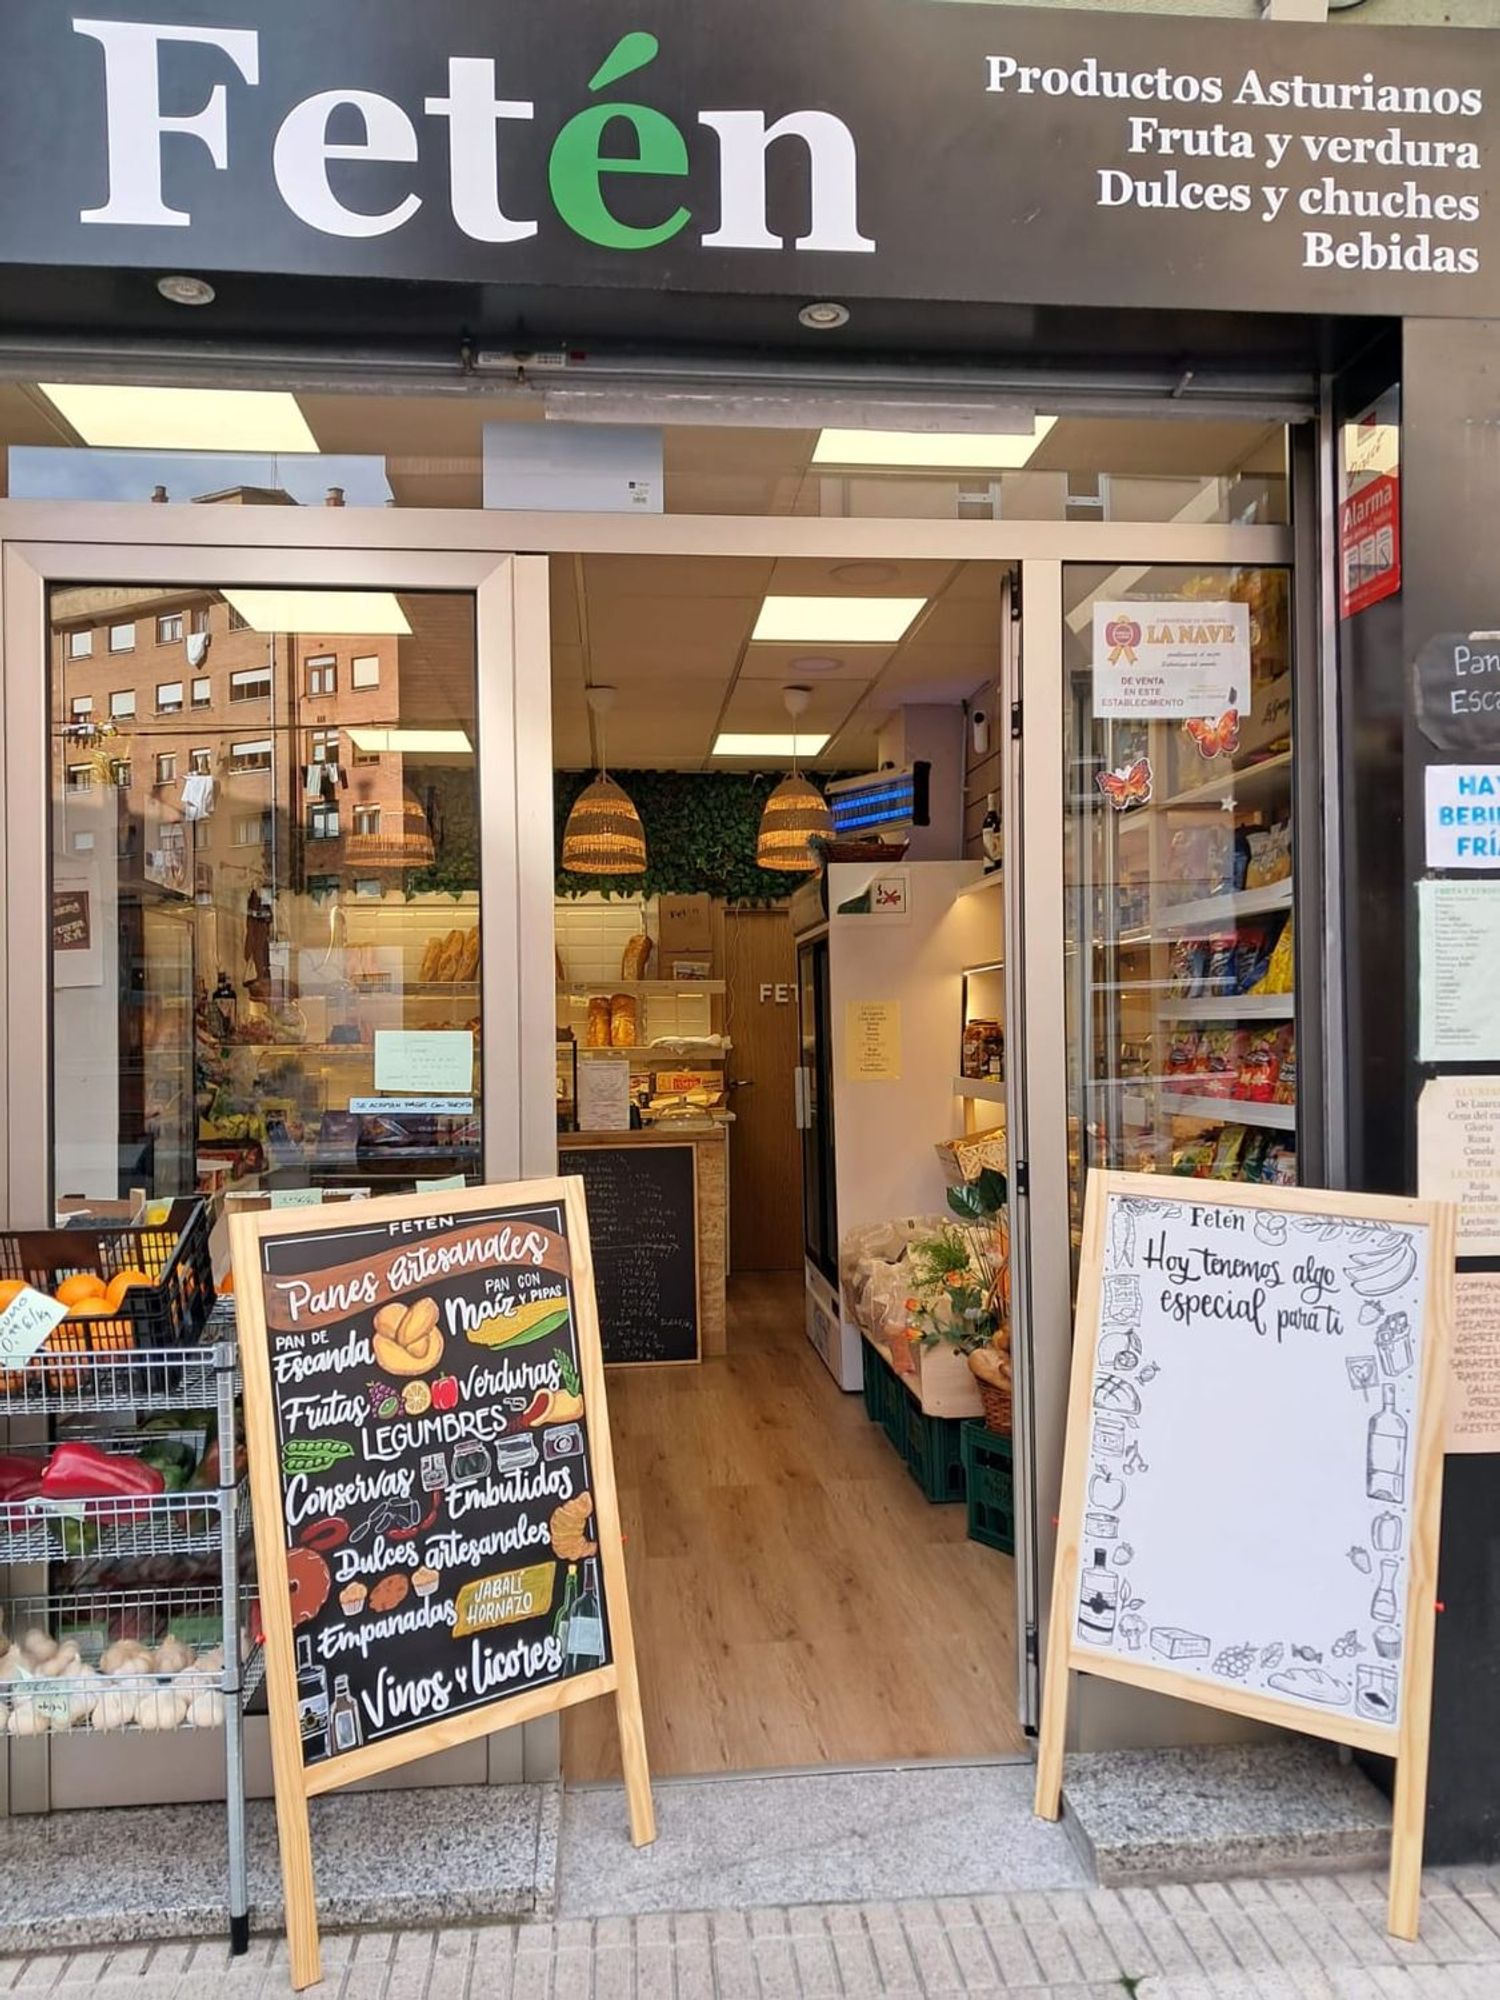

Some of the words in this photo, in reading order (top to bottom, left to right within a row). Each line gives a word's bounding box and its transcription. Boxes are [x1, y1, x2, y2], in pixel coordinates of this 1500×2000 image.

[985, 55, 1223, 104] Productos
[1232, 70, 1483, 116] Asturianos
[72, 18, 877, 253] Fetén
[1128, 117, 1255, 159] Fruta
[1265, 132, 1292, 170] y
[1301, 128, 1481, 170] verdura
[1097, 169, 1252, 212] Dulces
[1262, 186, 1289, 222] y
[1299, 179, 1480, 222] chuches
[1303, 232, 1480, 274] Bebidas
[1343, 483, 1393, 533] Alarma
[1147, 624, 1175, 645] LA
[1179, 624, 1236, 645] NAVE
[1102, 698, 1184, 707] ESTABLECIMIENTO
[1121, 676, 1135, 686] DE
[1136, 676, 1165, 686] VENTA
[1124, 687, 1136, 696] EN
[1138, 687, 1161, 696] ESTE
[388, 1214, 456, 1237] FETÉN
[1189, 1206, 1246, 1231] Fetén
[276, 1273, 380, 1322] Panes
[387, 1226, 550, 1293] Artesanales
[485, 1277, 510, 1294] PAN
[517, 1272, 541, 1289] CON
[1143, 1231, 1201, 1285] Hoy
[1190, 1247, 1286, 1289] tenemos
[1292, 1255, 1341, 1305] algo
[445, 1293, 518, 1336] Maíz
[530, 1285, 563, 1301] PIPAS
[1160, 1288, 1267, 1336] especial
[1277, 1308, 1320, 1343] para
[1316, 1304, 1344, 1336] ti
[273, 1331, 375, 1385] Escanda
[275, 1335, 305, 1351] PAN
[311, 1330, 329, 1346] DE
[280, 1392, 371, 1435] Frutas
[459, 1357, 562, 1401] Verduras
[361, 1405, 508, 1461] LEGUMBRES
[285, 1466, 415, 1527] Conservas
[444, 1463, 573, 1519] Embutidos
[334, 1535, 420, 1584] Dulces
[466, 1592, 534, 1626] HORNAZO
[474, 1570, 525, 1603] JABALÍ
[317, 1595, 459, 1659] Empanadas
[361, 1666, 453, 1729] Vinos
